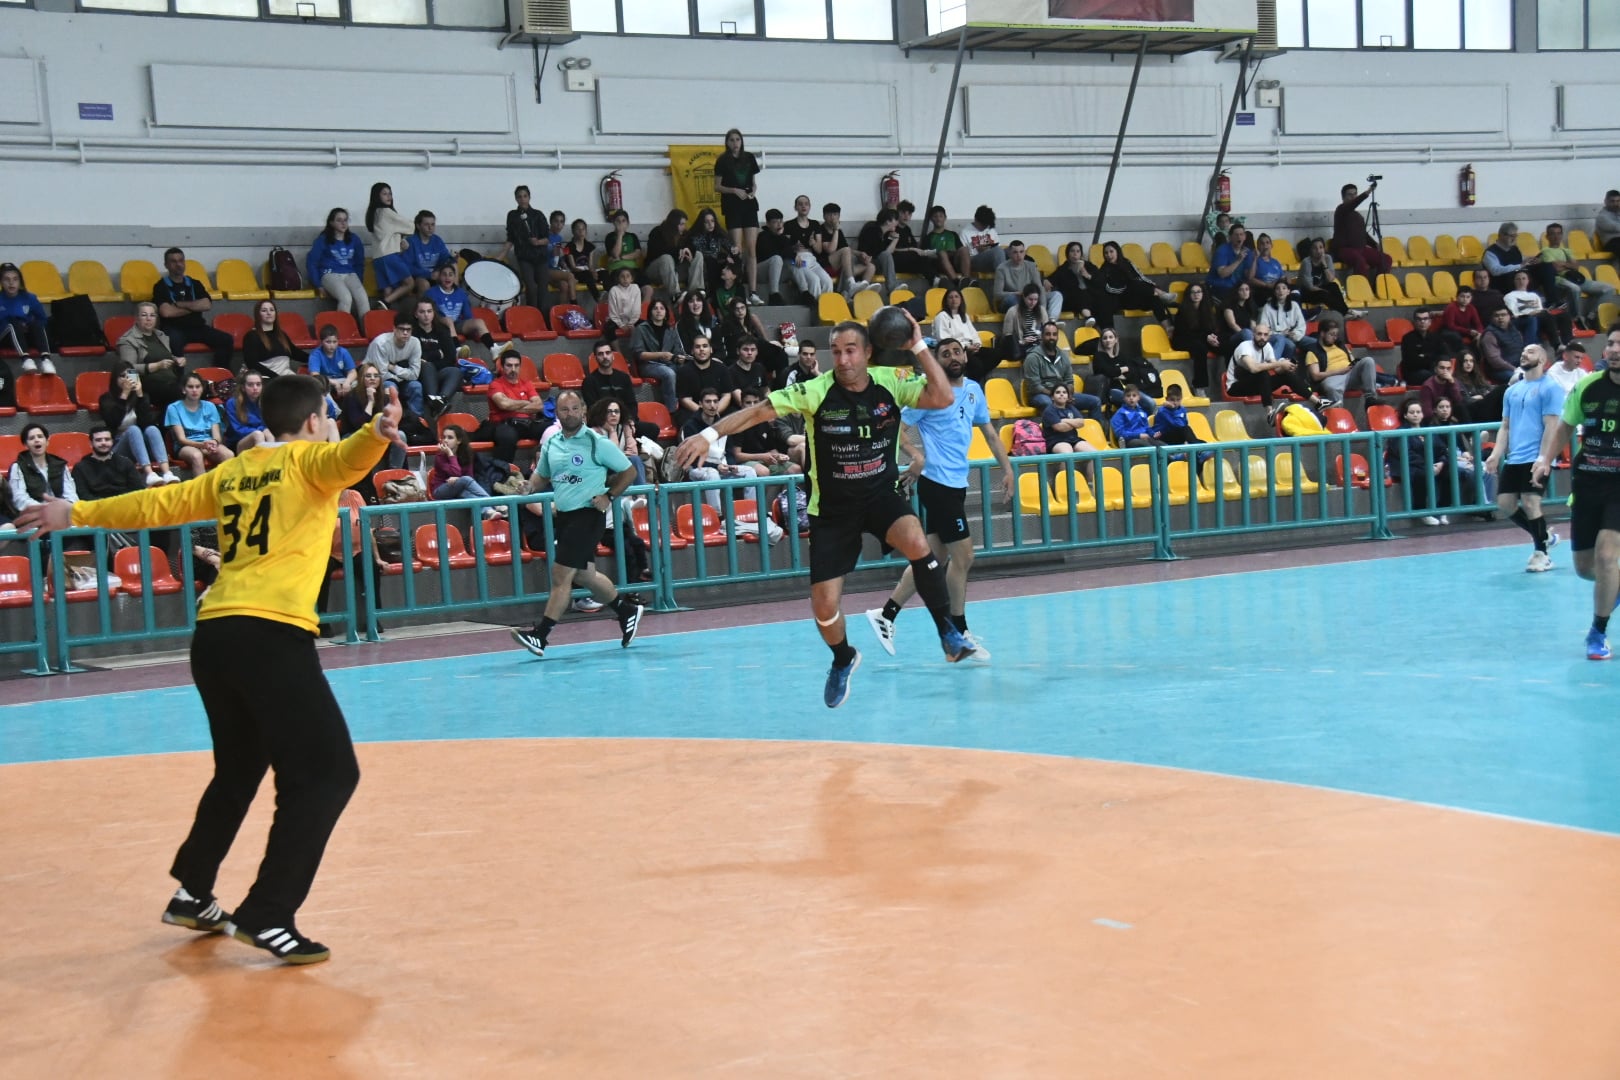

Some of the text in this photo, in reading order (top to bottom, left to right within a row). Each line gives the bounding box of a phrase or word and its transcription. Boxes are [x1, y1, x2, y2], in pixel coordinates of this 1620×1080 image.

[960, 407, 964, 418] 3
[1601, 419, 1616, 432] 19
[858, 426, 871, 438] 11
[224, 494, 270, 563] 34
[957, 519, 964, 531] 3
